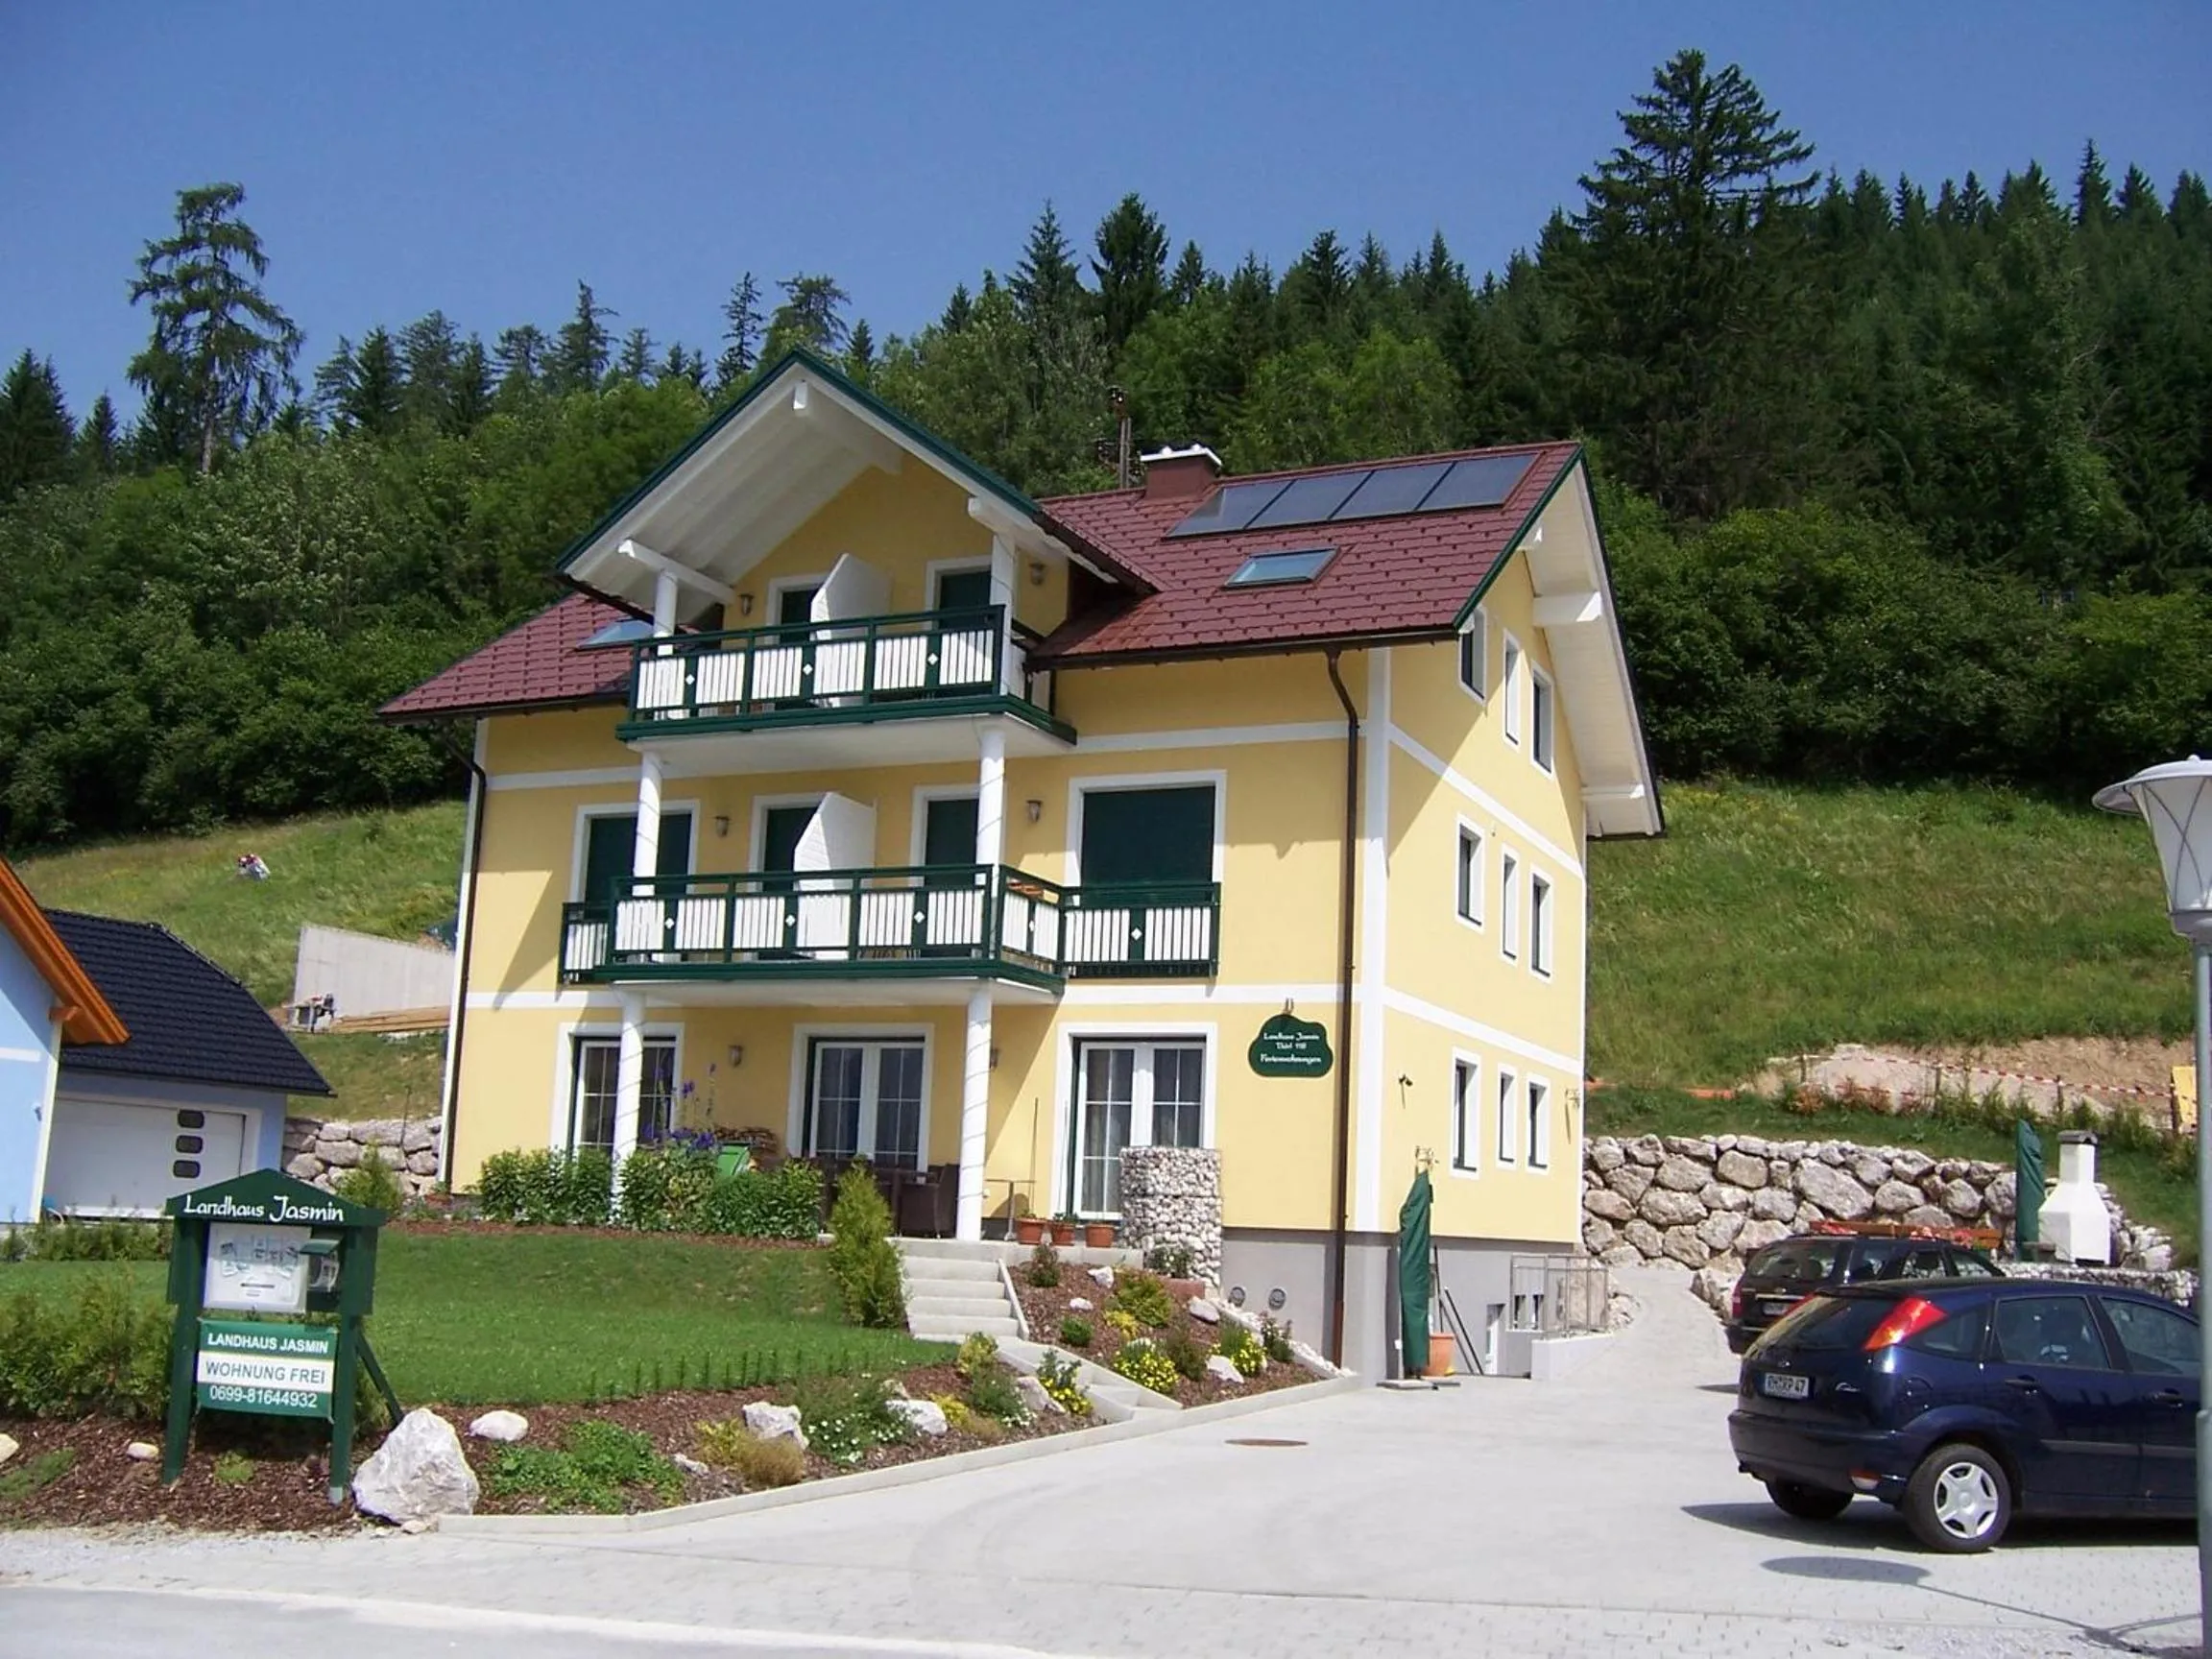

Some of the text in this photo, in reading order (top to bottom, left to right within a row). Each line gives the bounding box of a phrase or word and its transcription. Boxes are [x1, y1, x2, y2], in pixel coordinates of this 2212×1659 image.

[183, 1194, 344, 1222] Landhaus Jasmin
[207, 1333, 328, 1354] LANDHAUS JASMIN
[205, 1360, 325, 1383] WOHNUNG FREI
[209, 1385, 318, 1407] 0699-81644932
